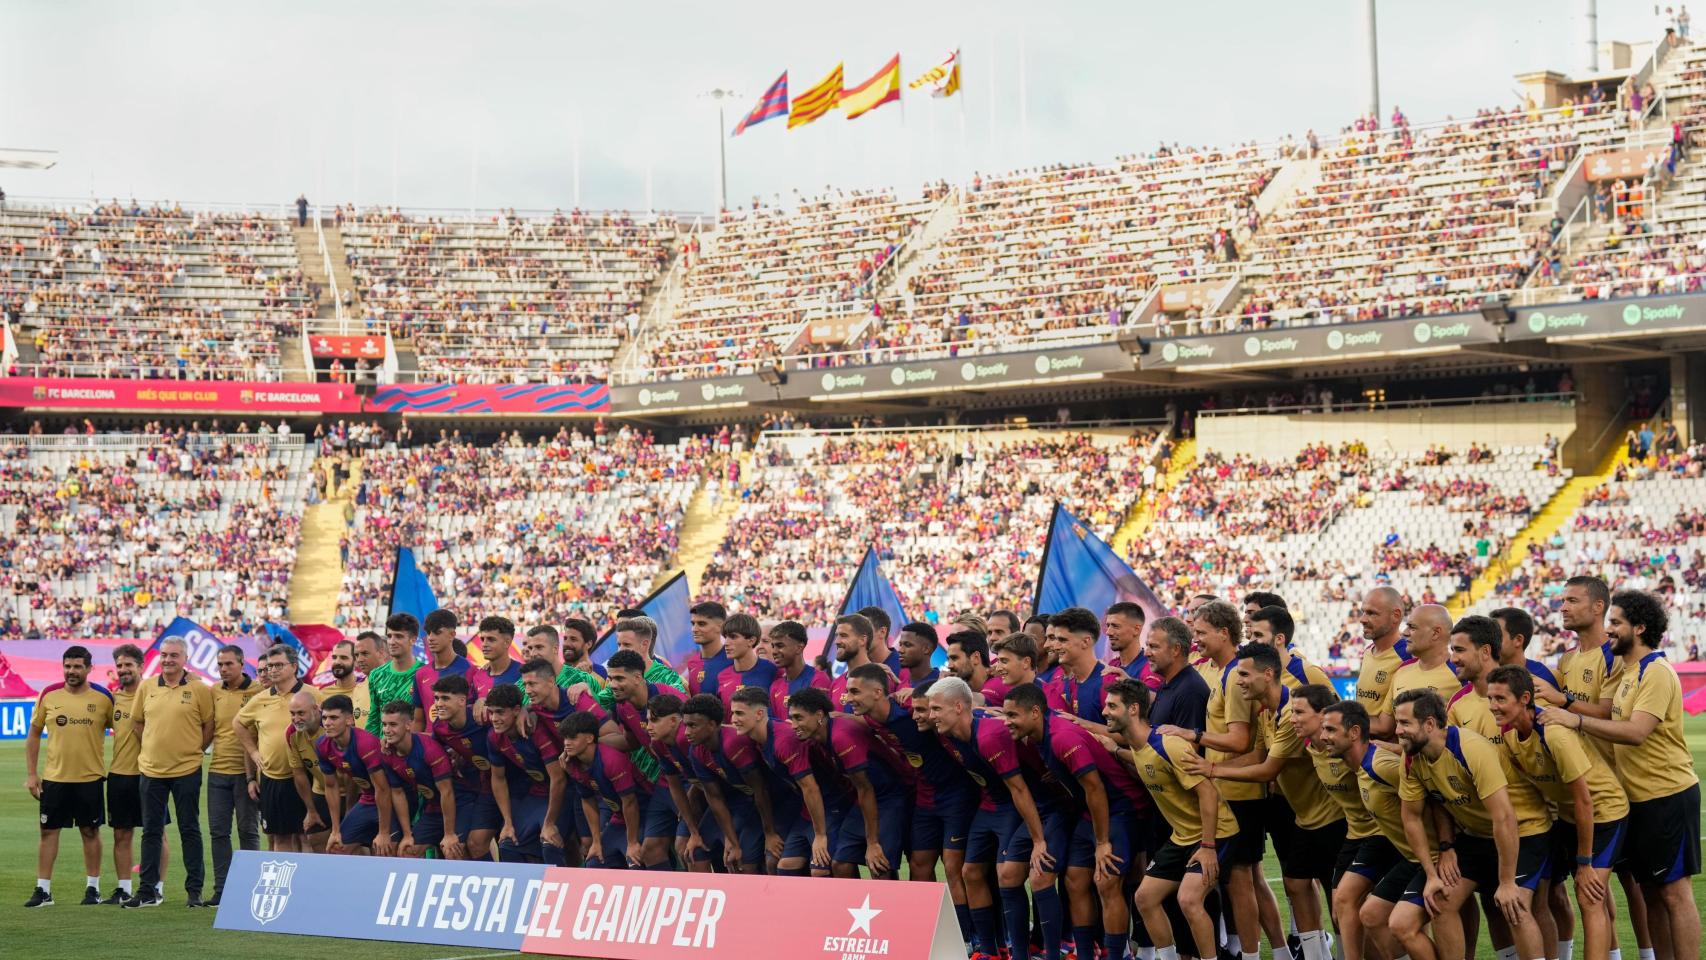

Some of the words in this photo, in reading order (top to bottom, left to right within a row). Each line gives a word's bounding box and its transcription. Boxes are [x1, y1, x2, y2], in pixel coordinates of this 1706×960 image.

[1546, 312, 1589, 328] Spotify
[1642, 304, 1685, 321] Spotify
[1432, 322, 1472, 338] Spotify
[1262, 337, 1298, 352] Spotify
[1344, 330, 1382, 346] Spotify
[1179, 344, 1215, 358] Spotify
[976, 362, 1009, 377] Spotify
[1050, 355, 1084, 370] Spotify
[835, 374, 866, 388] Spotify
[906, 368, 937, 381] Spotify
[48, 389, 60, 399] FC
[61, 389, 115, 400] BARCELONA
[137, 389, 157, 401] MÉS
[158, 390, 178, 402] QUE
[179, 391, 193, 402] UN
[194, 391, 218, 402] CLUB
[255, 391, 266, 402] FC
[267, 392, 320, 403] BARCELONA
[652, 390, 680, 402] Spotify
[715, 384, 744, 397] Spotify
[2, 706, 26, 735] LA
[69, 716, 94, 727] Spotify
[375, 872, 419, 927] LA
[417, 874, 515, 933] FESTA
[514, 879, 570, 938] DEL
[571, 884, 727, 949] GAMPER
[823, 936, 889, 955] ESTRELLA
